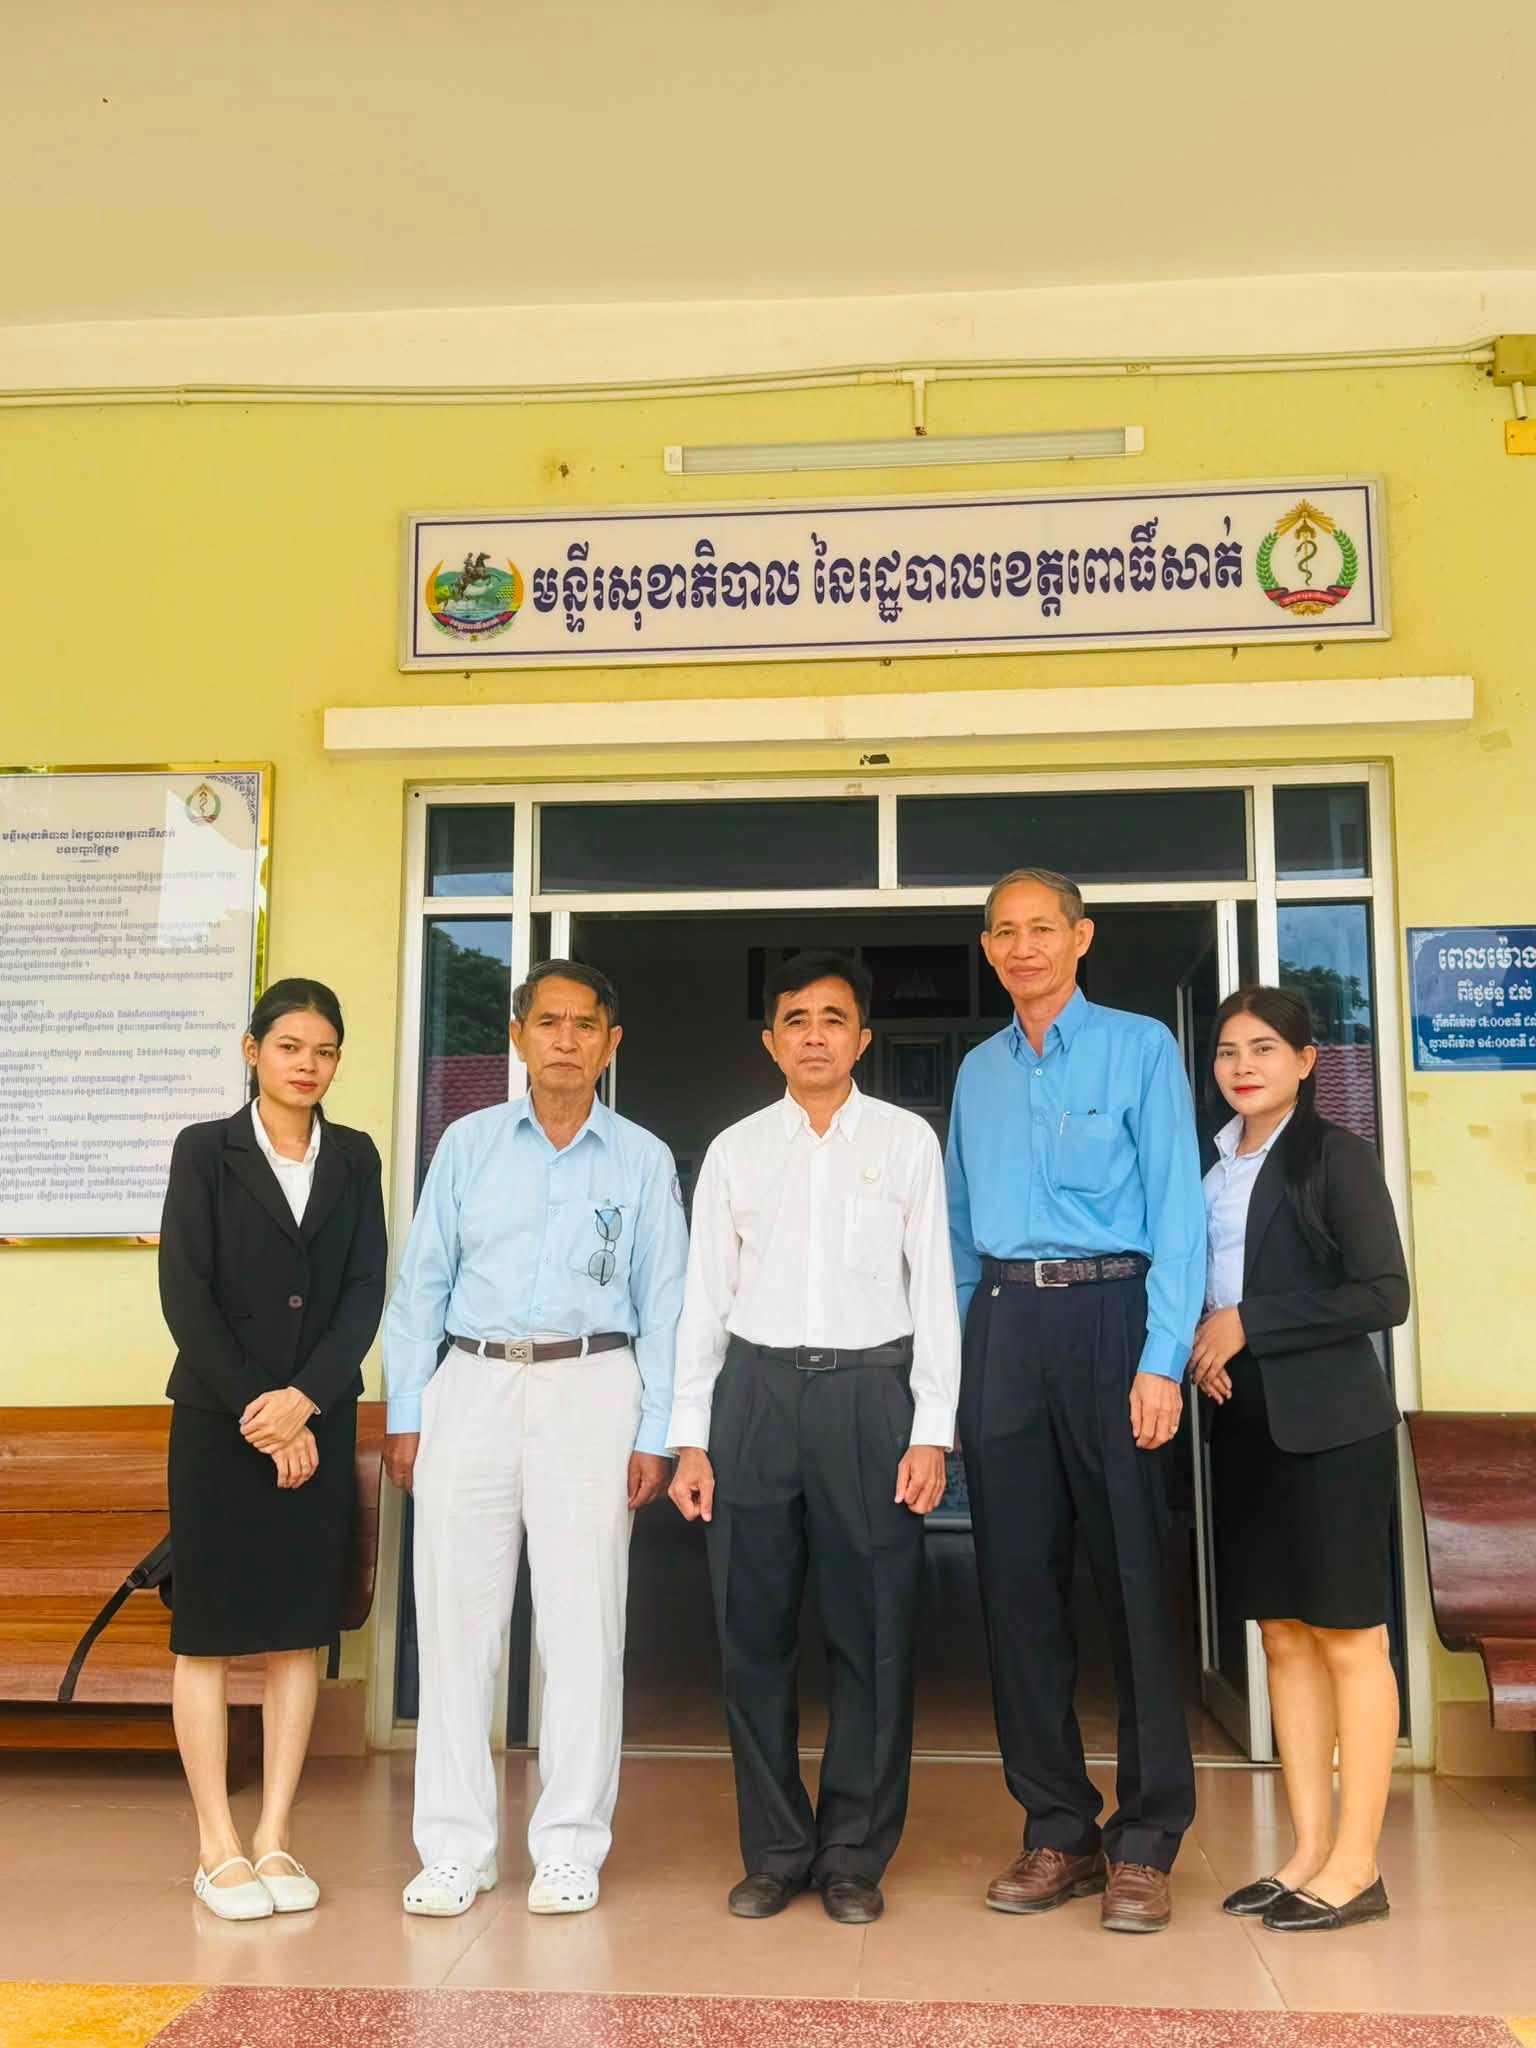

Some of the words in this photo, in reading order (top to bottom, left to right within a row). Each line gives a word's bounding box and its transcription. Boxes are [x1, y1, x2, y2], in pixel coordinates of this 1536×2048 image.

[532, 538, 800, 633] មន្ទីរសុខាភិបាល
